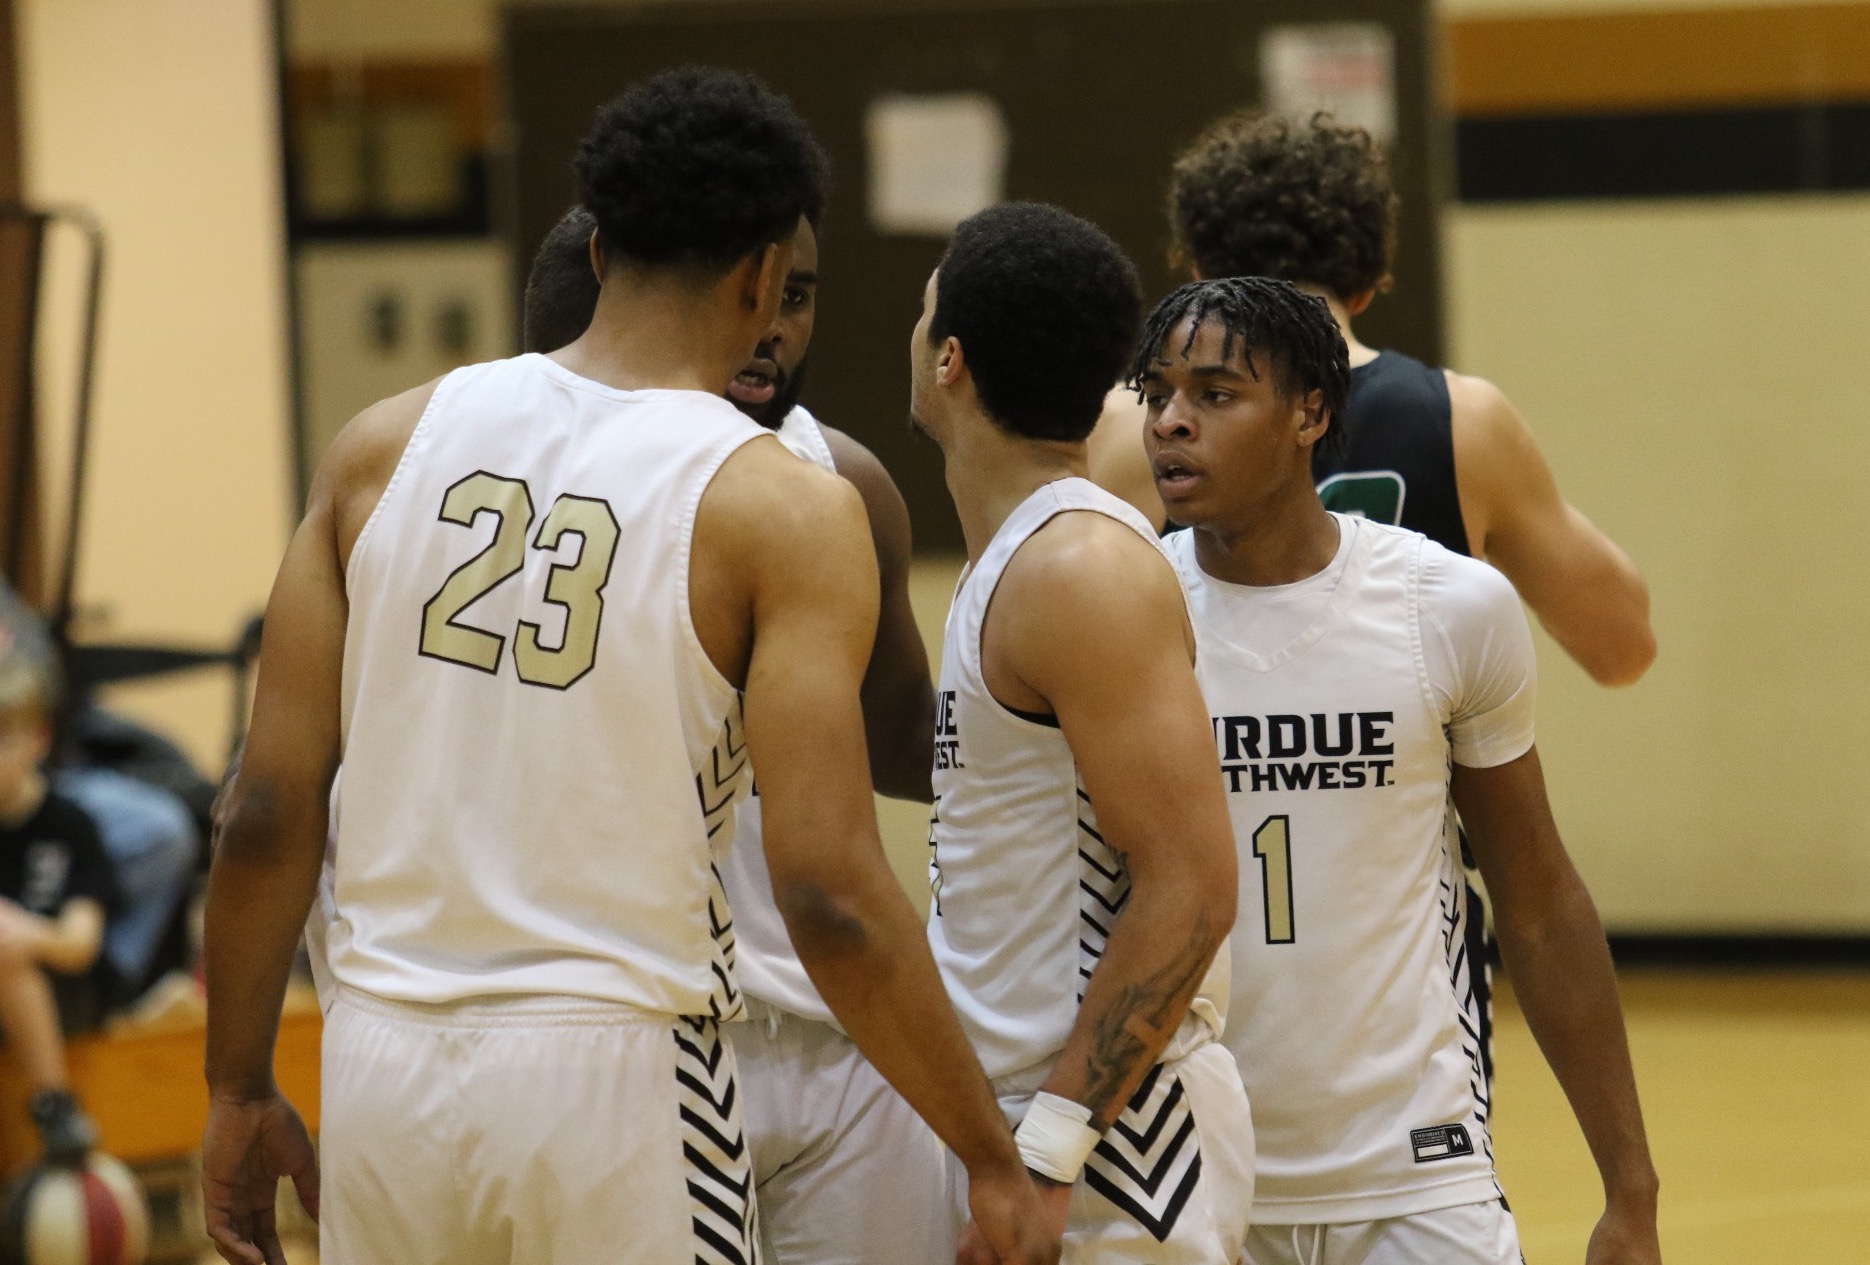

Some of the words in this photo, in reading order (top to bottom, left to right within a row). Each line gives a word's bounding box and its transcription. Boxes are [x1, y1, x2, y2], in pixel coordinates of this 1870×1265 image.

[418, 469, 622, 691] 23
[1212, 711, 1394, 760] RDUE
[1252, 815, 1296, 945] 1
[1451, 1133, 1464, 1147] M
